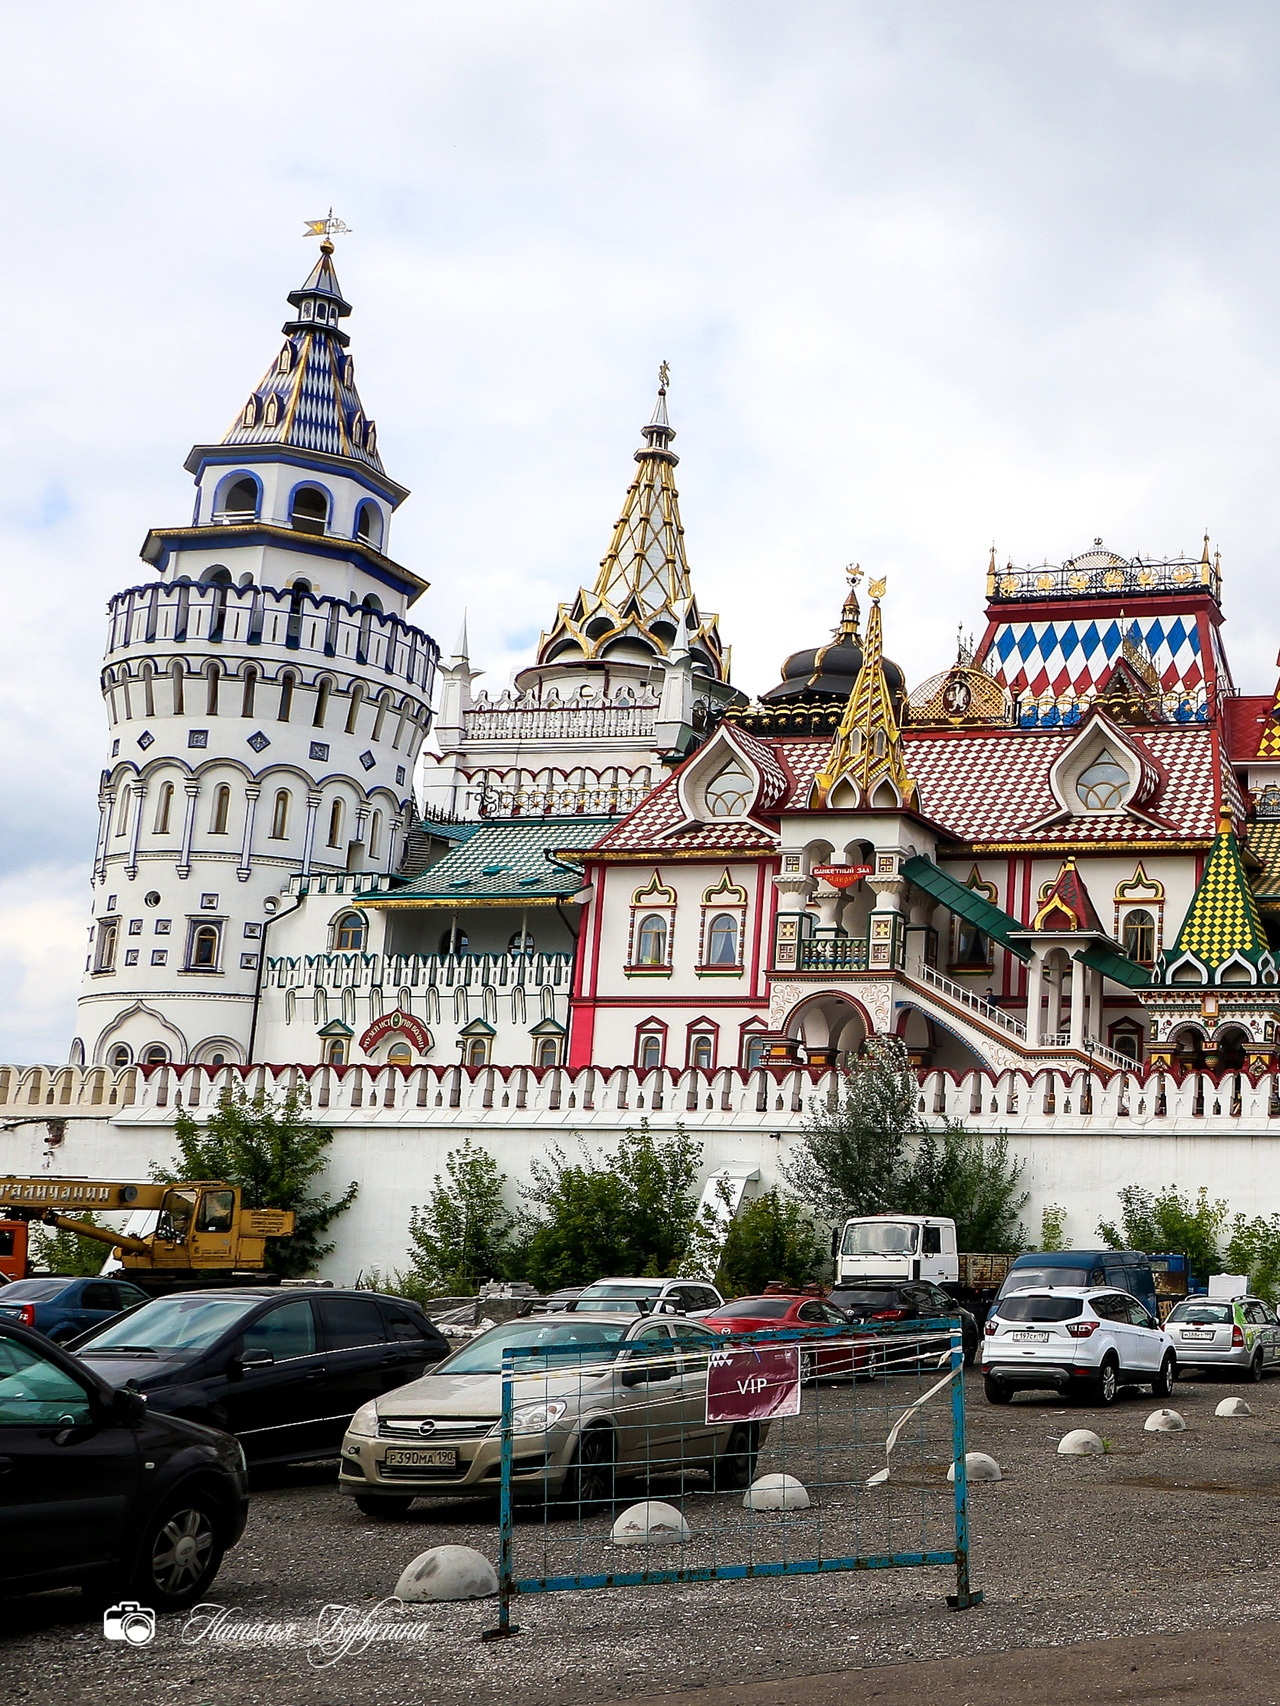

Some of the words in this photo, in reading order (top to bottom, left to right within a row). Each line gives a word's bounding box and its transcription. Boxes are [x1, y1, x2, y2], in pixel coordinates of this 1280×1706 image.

[737, 1378, 768, 1395] VIP
[389, 1452, 434, 1465] Р390МА
[436, 1451, 453, 1461] 190
